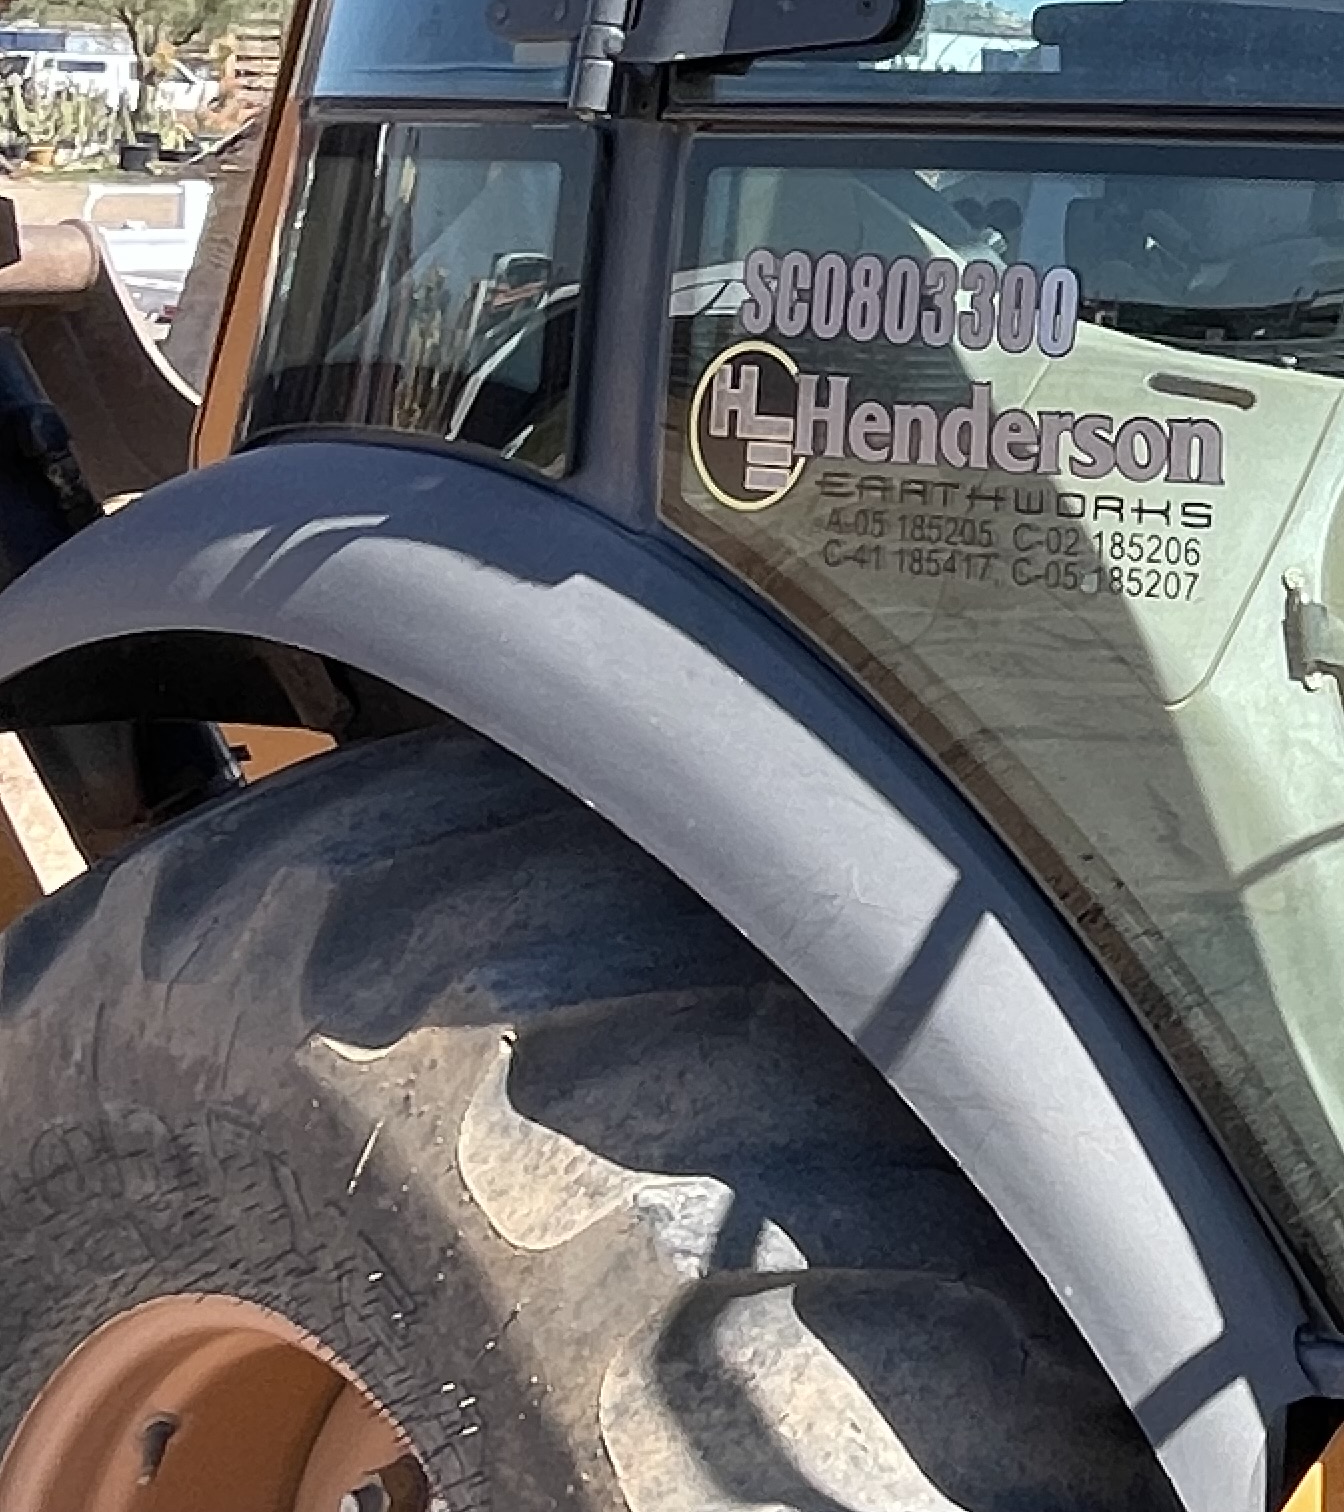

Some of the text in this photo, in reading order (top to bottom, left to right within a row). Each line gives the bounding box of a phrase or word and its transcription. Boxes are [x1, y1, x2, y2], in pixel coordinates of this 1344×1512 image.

[794, 372, 1227, 486] Henderson
[814, 471, 1214, 529] EARTHWORKS
[821, 538, 885, 572] C-41
[897, 546, 999, 582] 185417
[1090, 564, 1202, 603] 185207
[897, 513, 994, 549] 185205
[1011, 520, 1081, 556] C-02
[1091, 530, 1203, 567] 185206
